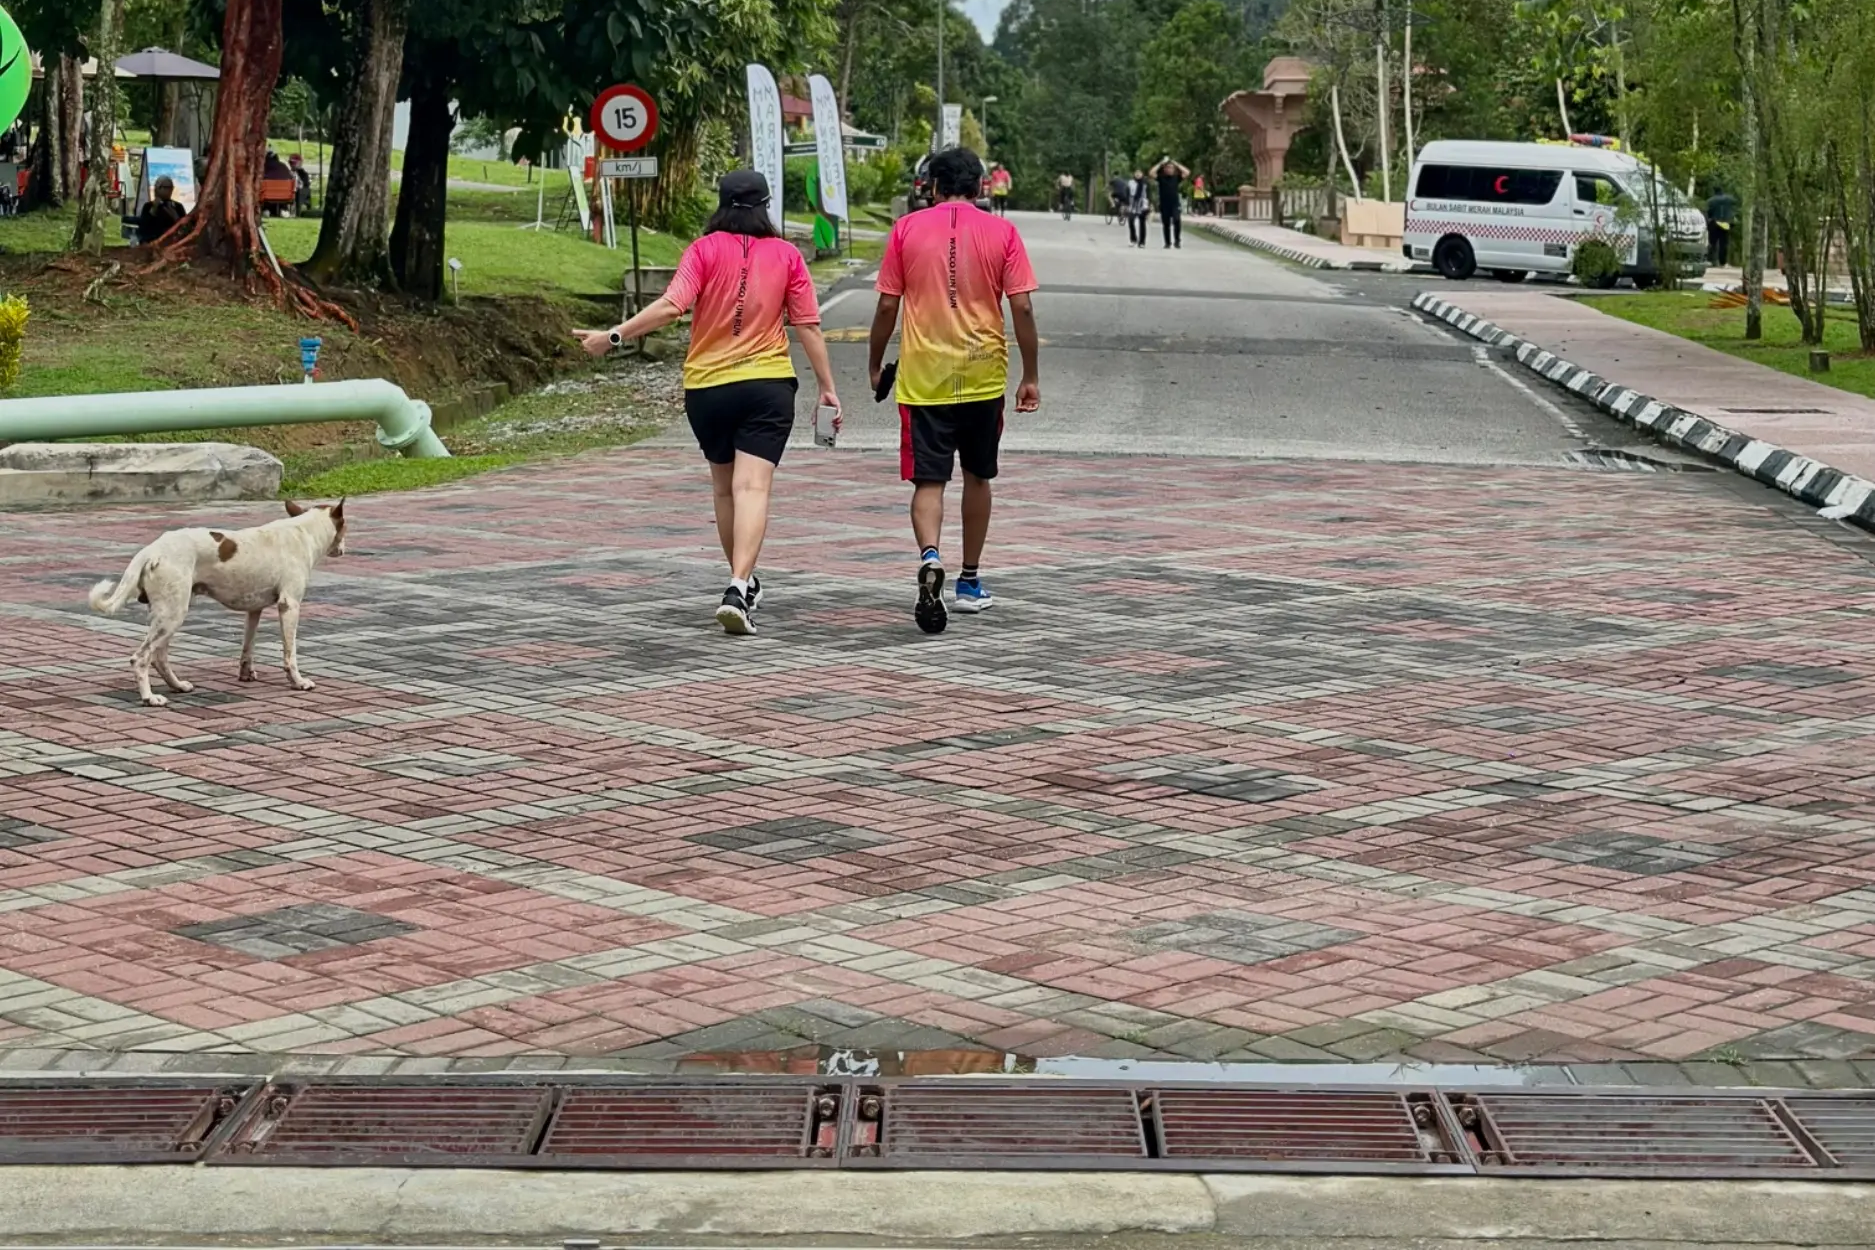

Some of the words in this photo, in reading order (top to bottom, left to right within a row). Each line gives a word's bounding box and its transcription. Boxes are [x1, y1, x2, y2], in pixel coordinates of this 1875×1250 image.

[614, 107, 637, 129] 15
[616, 161, 641, 173] km/j
[1492, 206, 1524, 216] MALAYSIA
[949, 237, 957, 268] WASCO
[739, 267, 748, 298] WASCO
[949, 269, 957, 287] FUN
[735, 299, 744, 317] FUN
[950, 290, 958, 309] RUN
[732, 319, 742, 336] RUN
